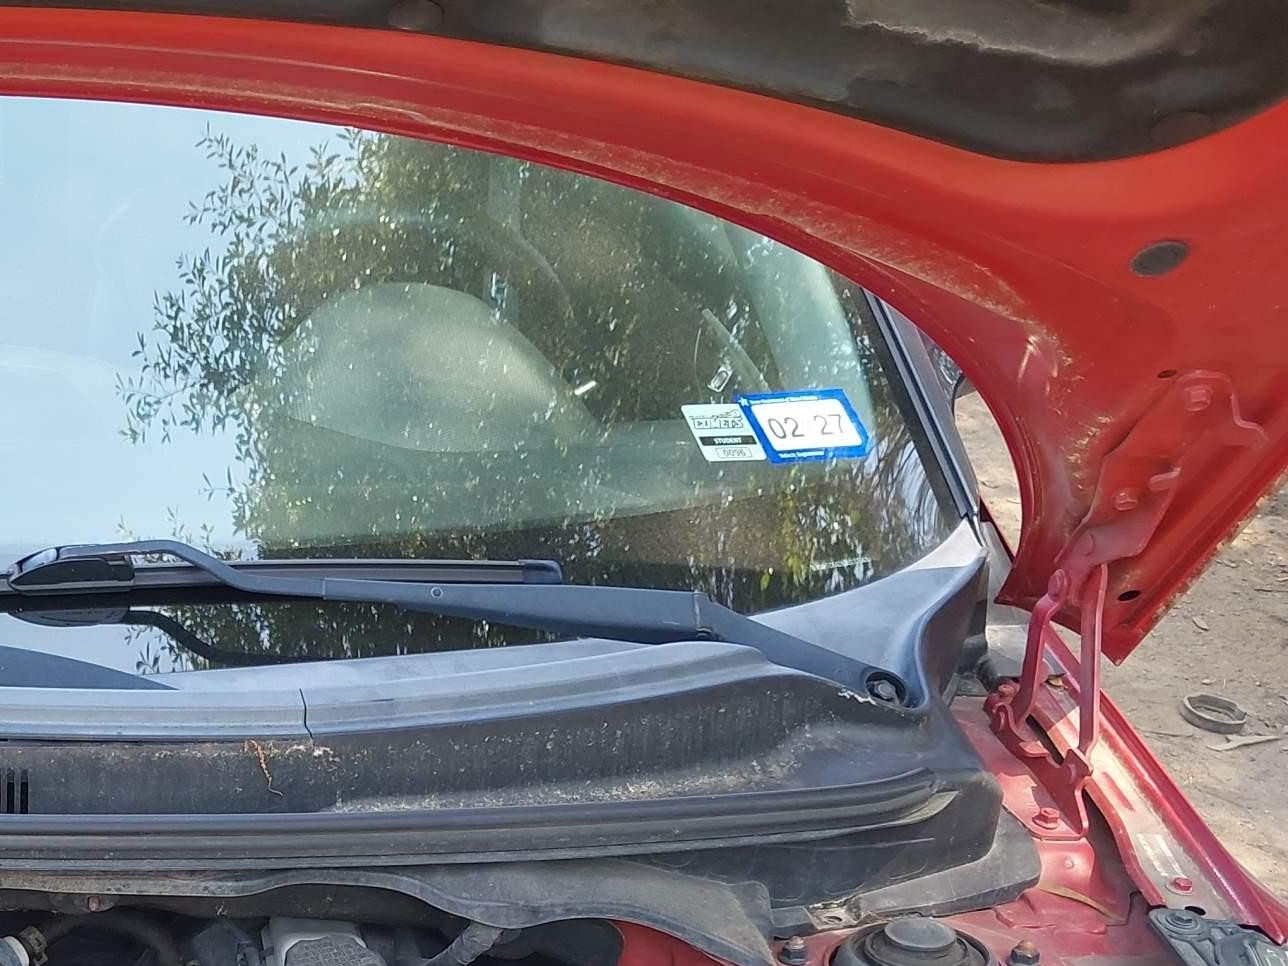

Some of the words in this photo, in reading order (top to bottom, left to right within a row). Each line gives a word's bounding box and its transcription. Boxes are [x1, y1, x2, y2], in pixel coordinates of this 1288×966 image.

[768, 417, 805, 439] 02
[813, 414, 844, 435] 27
[713, 437, 742, 445] STUDENT
